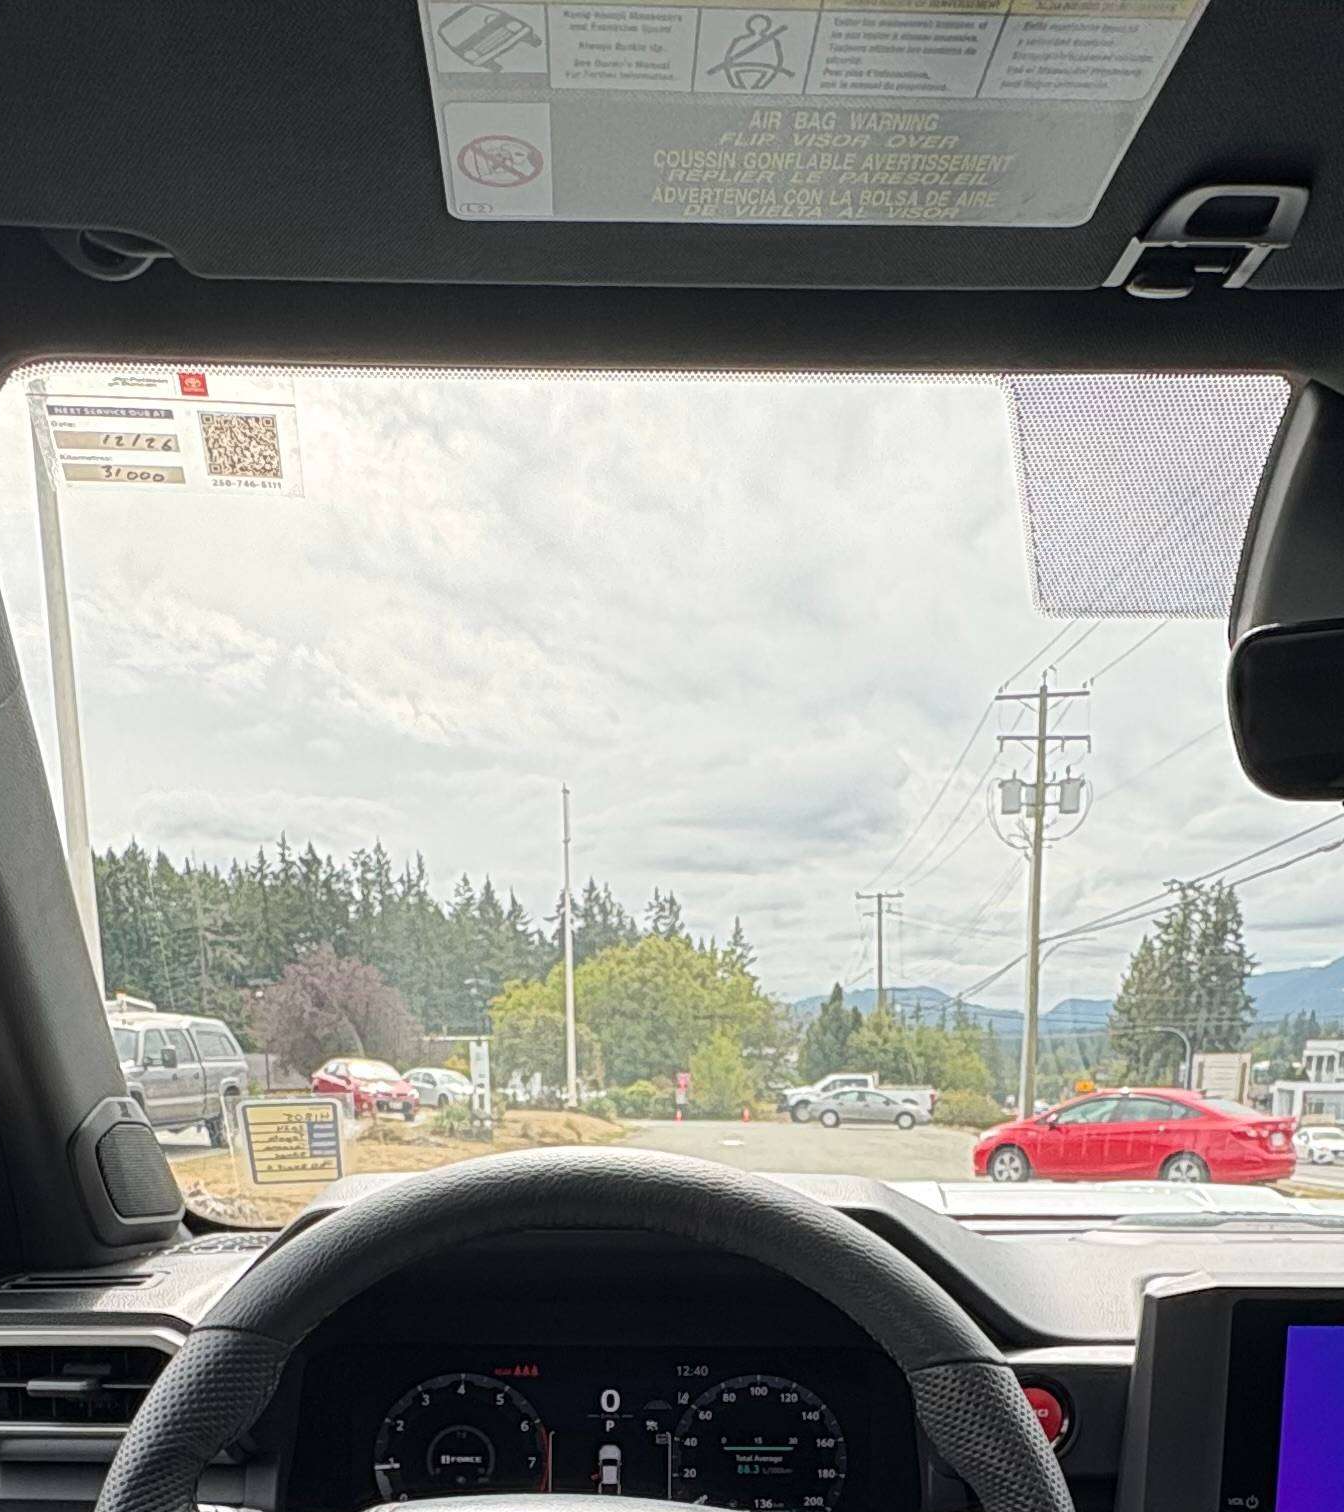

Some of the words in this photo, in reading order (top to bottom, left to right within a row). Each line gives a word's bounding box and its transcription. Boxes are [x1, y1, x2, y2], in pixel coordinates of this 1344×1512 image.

[749, 111, 782, 130] AIR
[793, 111, 837, 130] BAG
[850, 112, 940, 132] WARNING
[719, 132, 776, 147] FLIP
[793, 133, 871, 148] VISOR
[887, 134, 960, 149] OVER
[654, 150, 736, 169] COUSSIN
[743, 152, 856, 171] GONFLABLE
[861, 153, 1016, 172] AVERTISSEMENT
[668, 169, 775, 183] REPLIER
[790, 170, 824, 184] LE
[838, 171, 989, 186] PARESOLEIL
[652, 187, 777, 205] ADVERTENCIA
[784, 188, 824, 206] CON
[829, 190, 852, 206] LA
[860, 189, 918, 207] BOLSA
[925, 190, 952, 207] DE
[958, 191, 996, 208] AIRE
[683, 205, 720, 217] DE
[735, 205, 823, 218] VUELTA
[836, 207, 865, 219] AL
[888, 207, 960, 220] VISOR
[676, 1365, 709, 1377] 12:40
[457, 1380, 466, 1395] 4
[750, 1386, 768, 1396] 100
[421, 1394, 430, 1407] 3
[496, 1393, 505, 1406] 5
[600, 1389, 621, 1413] 0
[722, 1393, 736, 1402] 80
[780, 1393, 798, 1403] 120
[698, 1411, 712, 1420] 60
[802, 1411, 819, 1421] 140
[396, 1420, 404, 1432] 2
[520, 1420, 530, 1432] 6
[605, 1420, 615, 1433] P
[684, 1437, 698, 1447] 40
[816, 1438, 834, 1448] 160
[528, 1457, 536, 1469] 7
[683, 1468, 696, 1478] 20
[818, 1469, 836, 1479] 180
[754, 1498, 773, 1509] 136
[804, 1496, 824, 1506] 200
